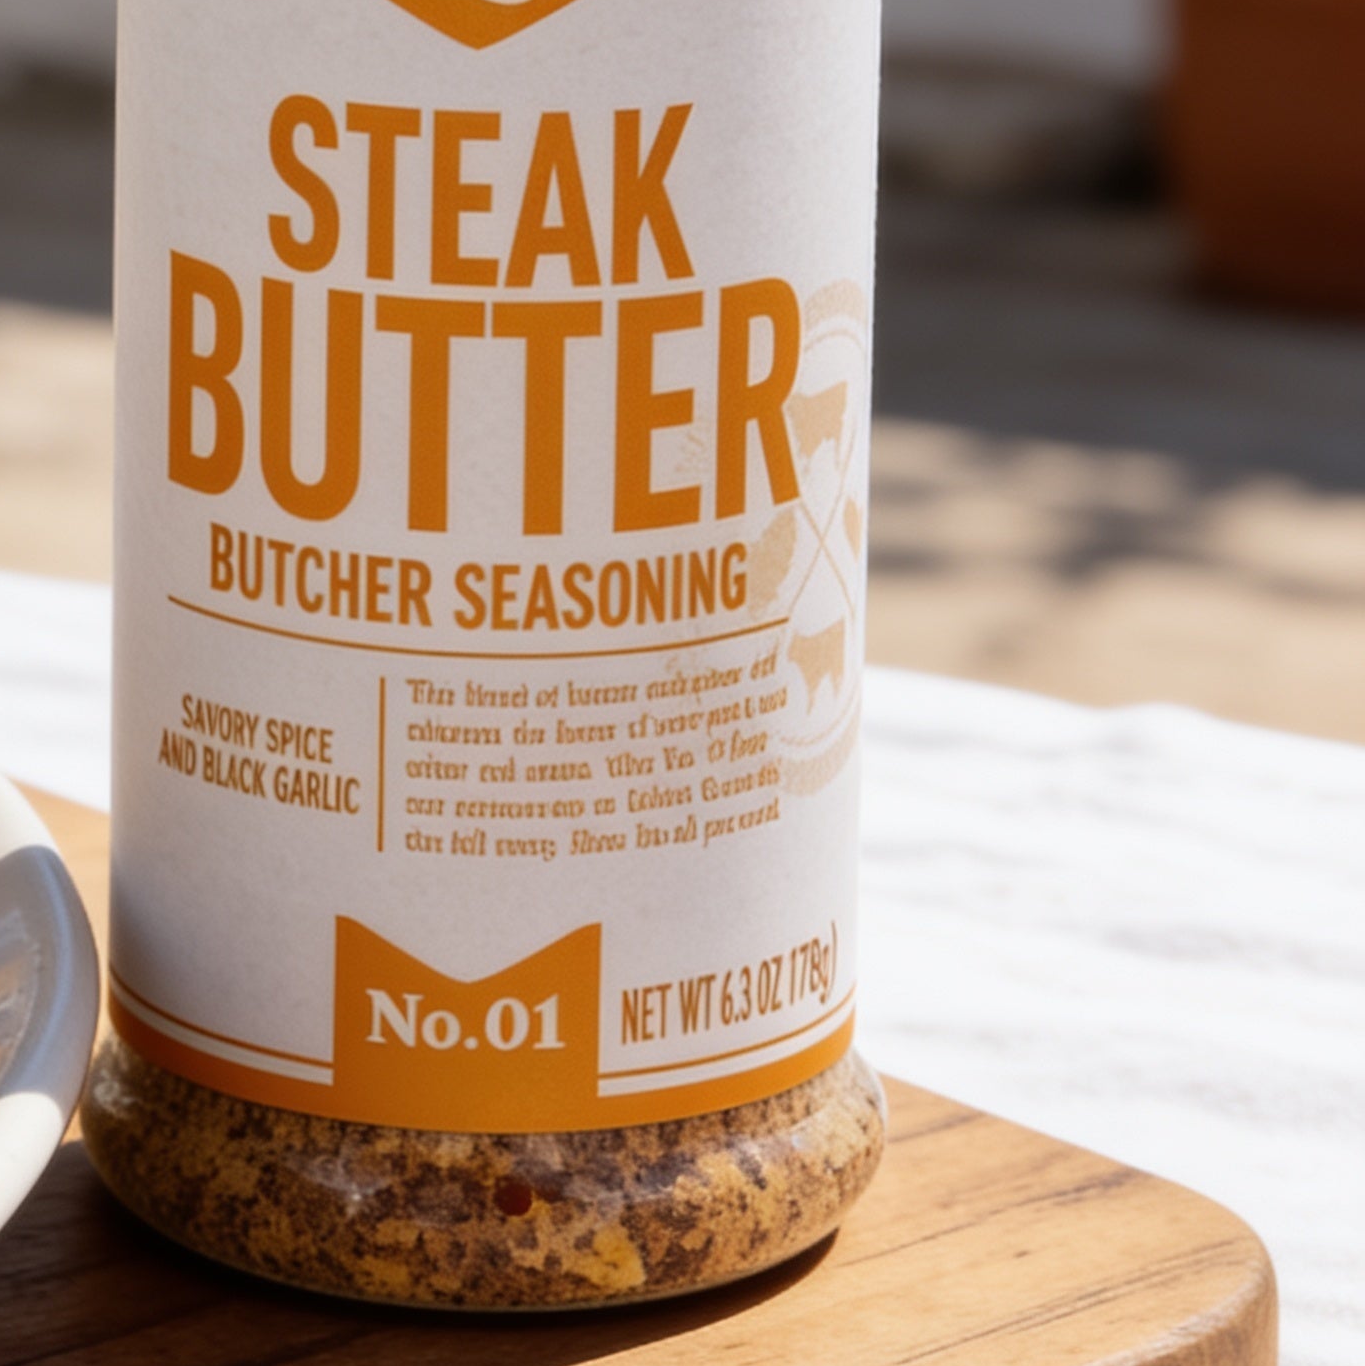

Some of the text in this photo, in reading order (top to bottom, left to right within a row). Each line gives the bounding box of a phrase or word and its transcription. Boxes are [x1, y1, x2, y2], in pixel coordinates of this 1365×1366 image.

[268, 94, 695, 288] STEAK
[167, 249, 801, 537] BUTTER
[209, 521, 747, 631] BUTCHER SEASONING
[159, 728, 196, 777] AND
[202, 744, 267, 799] BLACK
[273, 765, 360, 815] GARLIC
[181, 693, 333, 764] SAVORY SPICE
[366, 988, 566, 1051] No.01
[622, 982, 672, 1046] NET
[679, 973, 717, 1034] WT
[721, 965, 752, 1026] 6.3
[757, 954, 784, 1015] OZ
